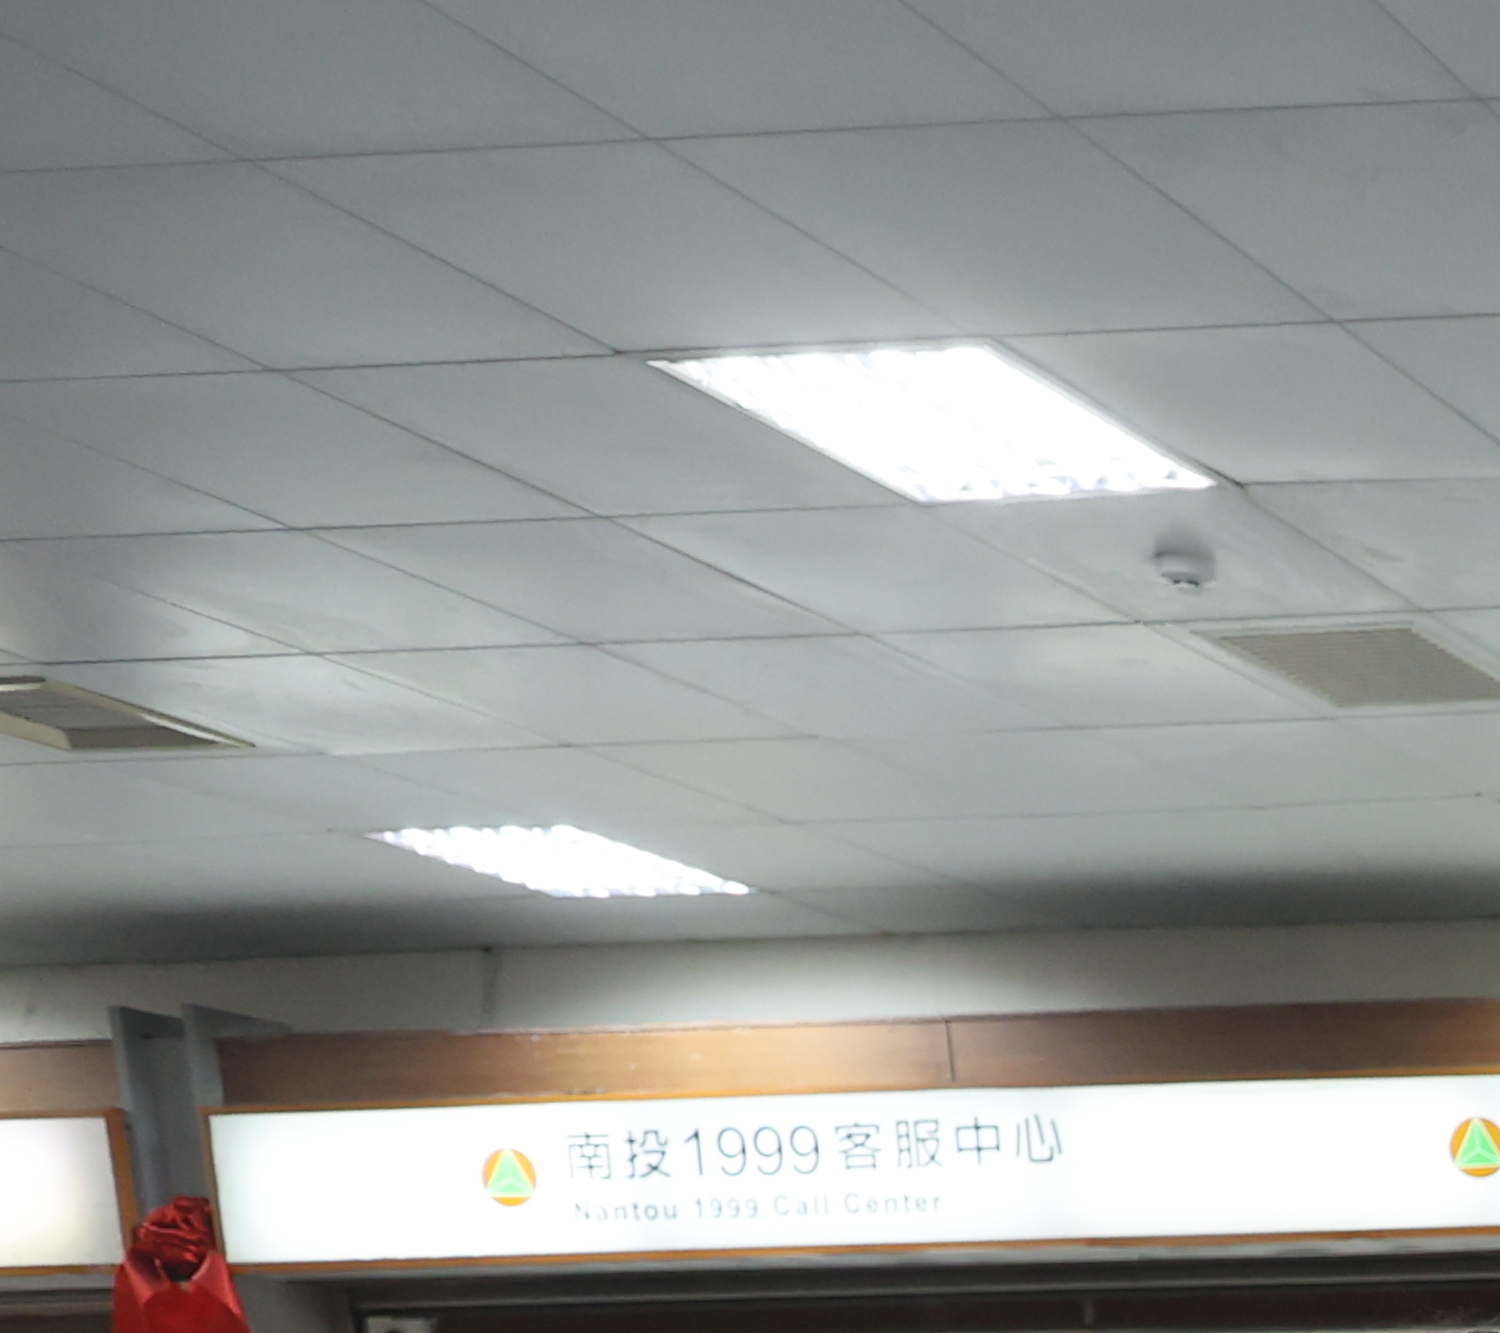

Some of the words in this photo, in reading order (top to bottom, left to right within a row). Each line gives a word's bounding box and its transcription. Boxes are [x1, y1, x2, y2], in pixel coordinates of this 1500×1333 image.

[566, 1111, 1065, 1182] 南投1999客服中心
[573, 1198, 680, 1223] Nantou
[692, 1198, 759, 1219] 1999
[775, 1194, 831, 1217] Call
[846, 1191, 943, 1215] Center
